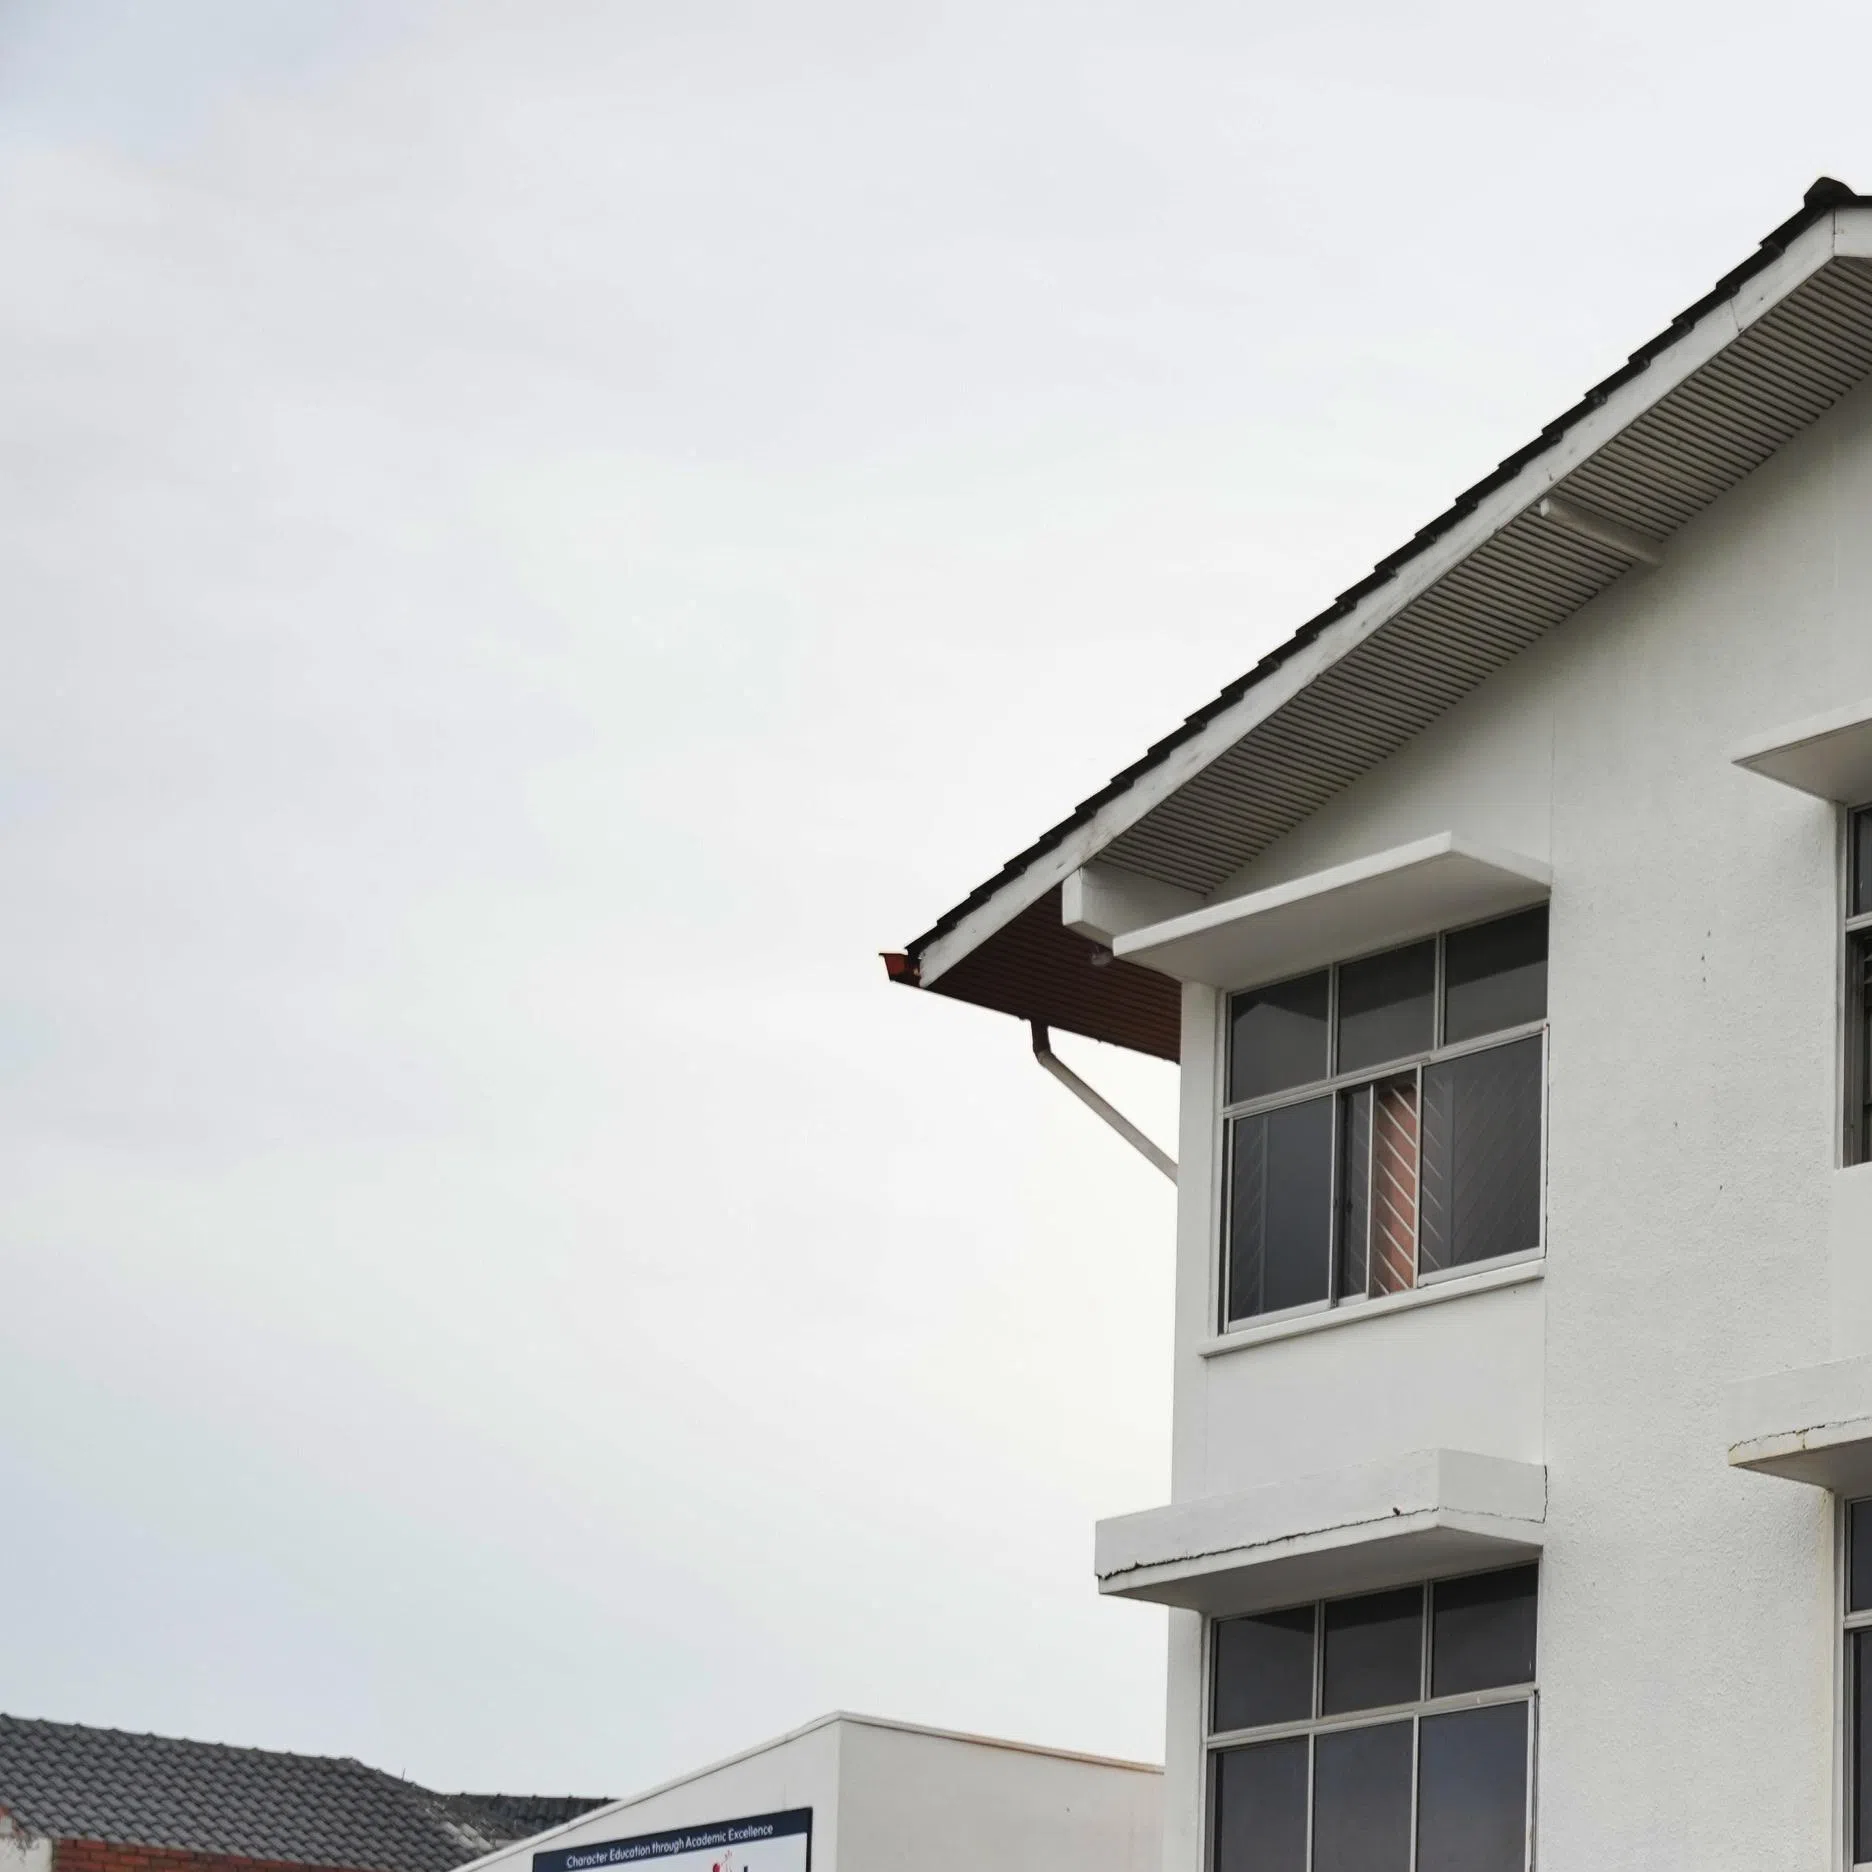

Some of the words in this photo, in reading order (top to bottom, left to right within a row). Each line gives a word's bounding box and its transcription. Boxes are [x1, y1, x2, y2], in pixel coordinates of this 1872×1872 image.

[566, 1851, 608, 1869] Character
[609, 1845, 652, 1862] Education
[652, 1839, 685, 1856] through
[685, 1833, 727, 1849] Academic
[728, 1824, 774, 1841] Excellence
